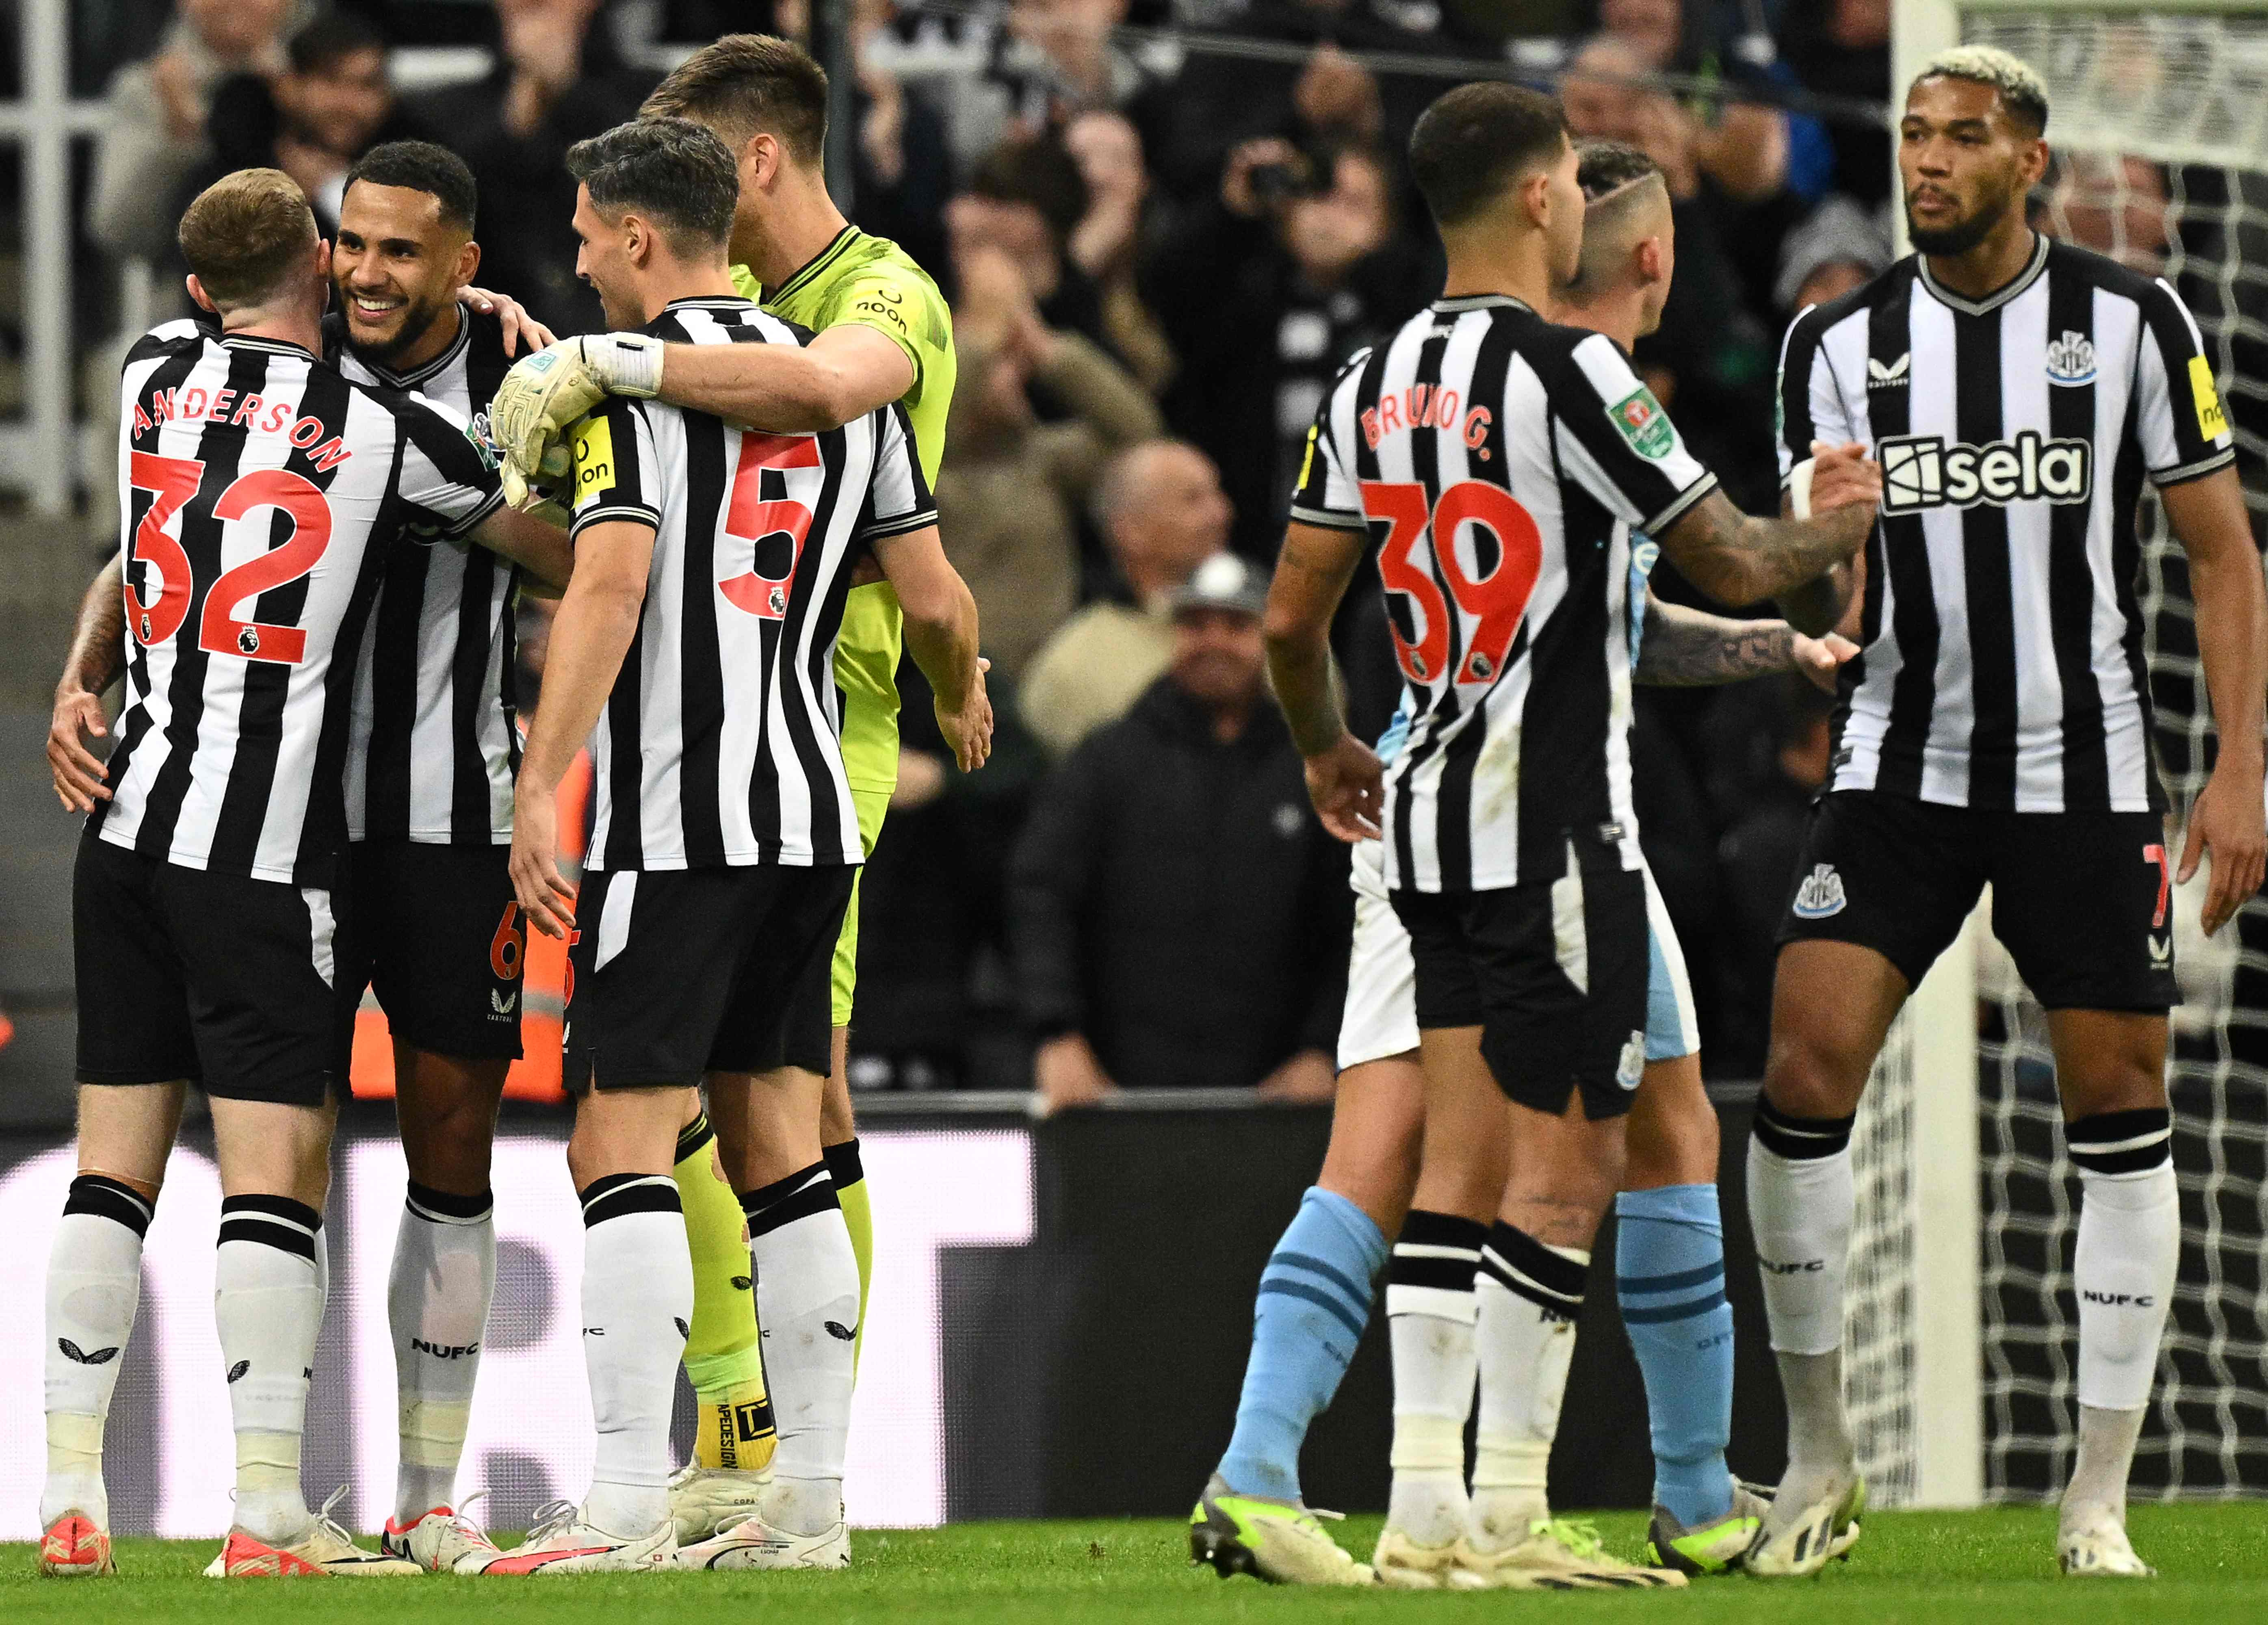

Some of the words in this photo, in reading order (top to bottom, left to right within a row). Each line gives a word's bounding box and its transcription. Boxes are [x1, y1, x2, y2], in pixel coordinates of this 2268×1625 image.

[856, 302, 907, 336] noon
[133, 386, 354, 473] ANDERSON
[1360, 383, 1459, 452] BRUNO
[1462, 405, 1493, 462] G.
[1946, 436, 2082, 500] sela
[124, 450, 334, 664] 32
[718, 431, 821, 620] 5
[1357, 479, 1543, 687] 39
[2142, 844, 2168, 928] 7
[490, 900, 522, 980] 6
[2084, 1290, 2153, 1306] NUFC
[412, 1338, 479, 1360] NUFC
